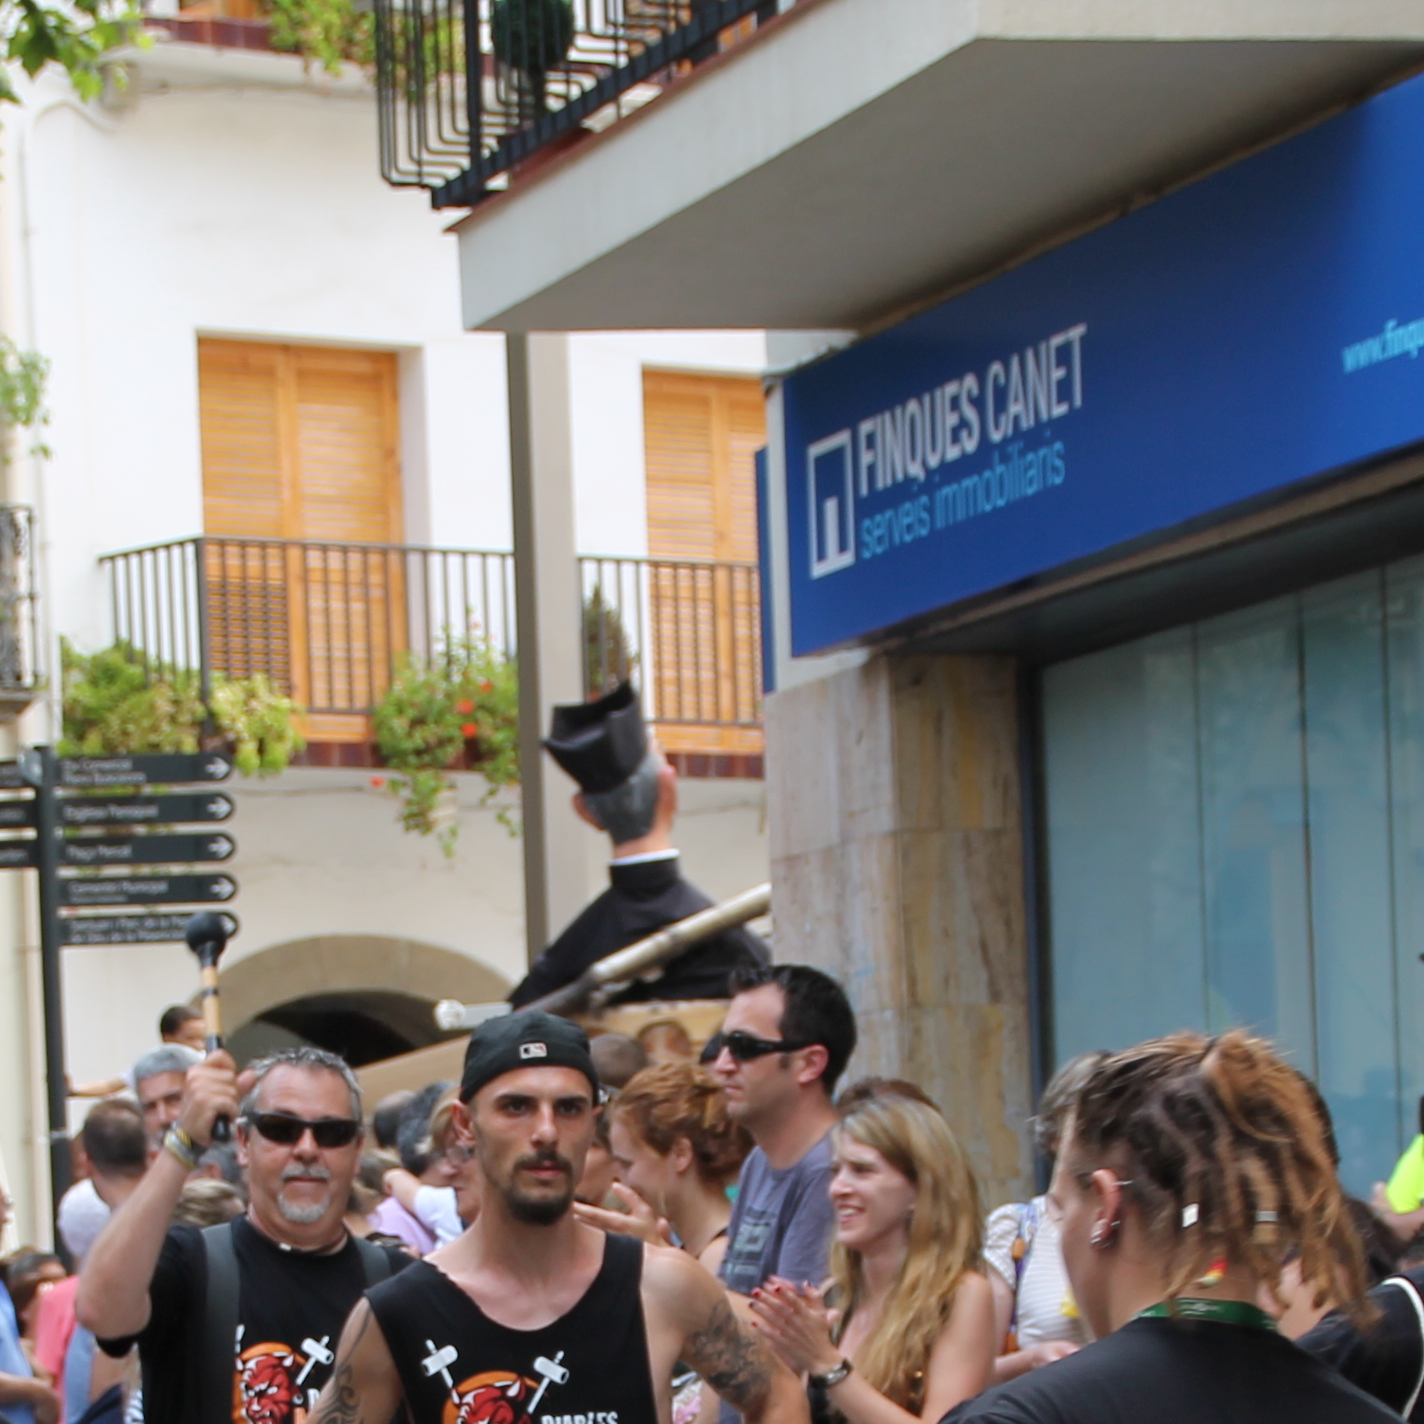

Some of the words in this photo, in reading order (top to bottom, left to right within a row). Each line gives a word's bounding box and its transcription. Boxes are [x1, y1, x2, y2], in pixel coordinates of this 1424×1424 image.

[857, 371, 981, 499] FINQUES
[985, 325, 1087, 444] CANET
[860, 473, 931, 560] serveis
[934, 428, 1066, 531] immobiliaris
